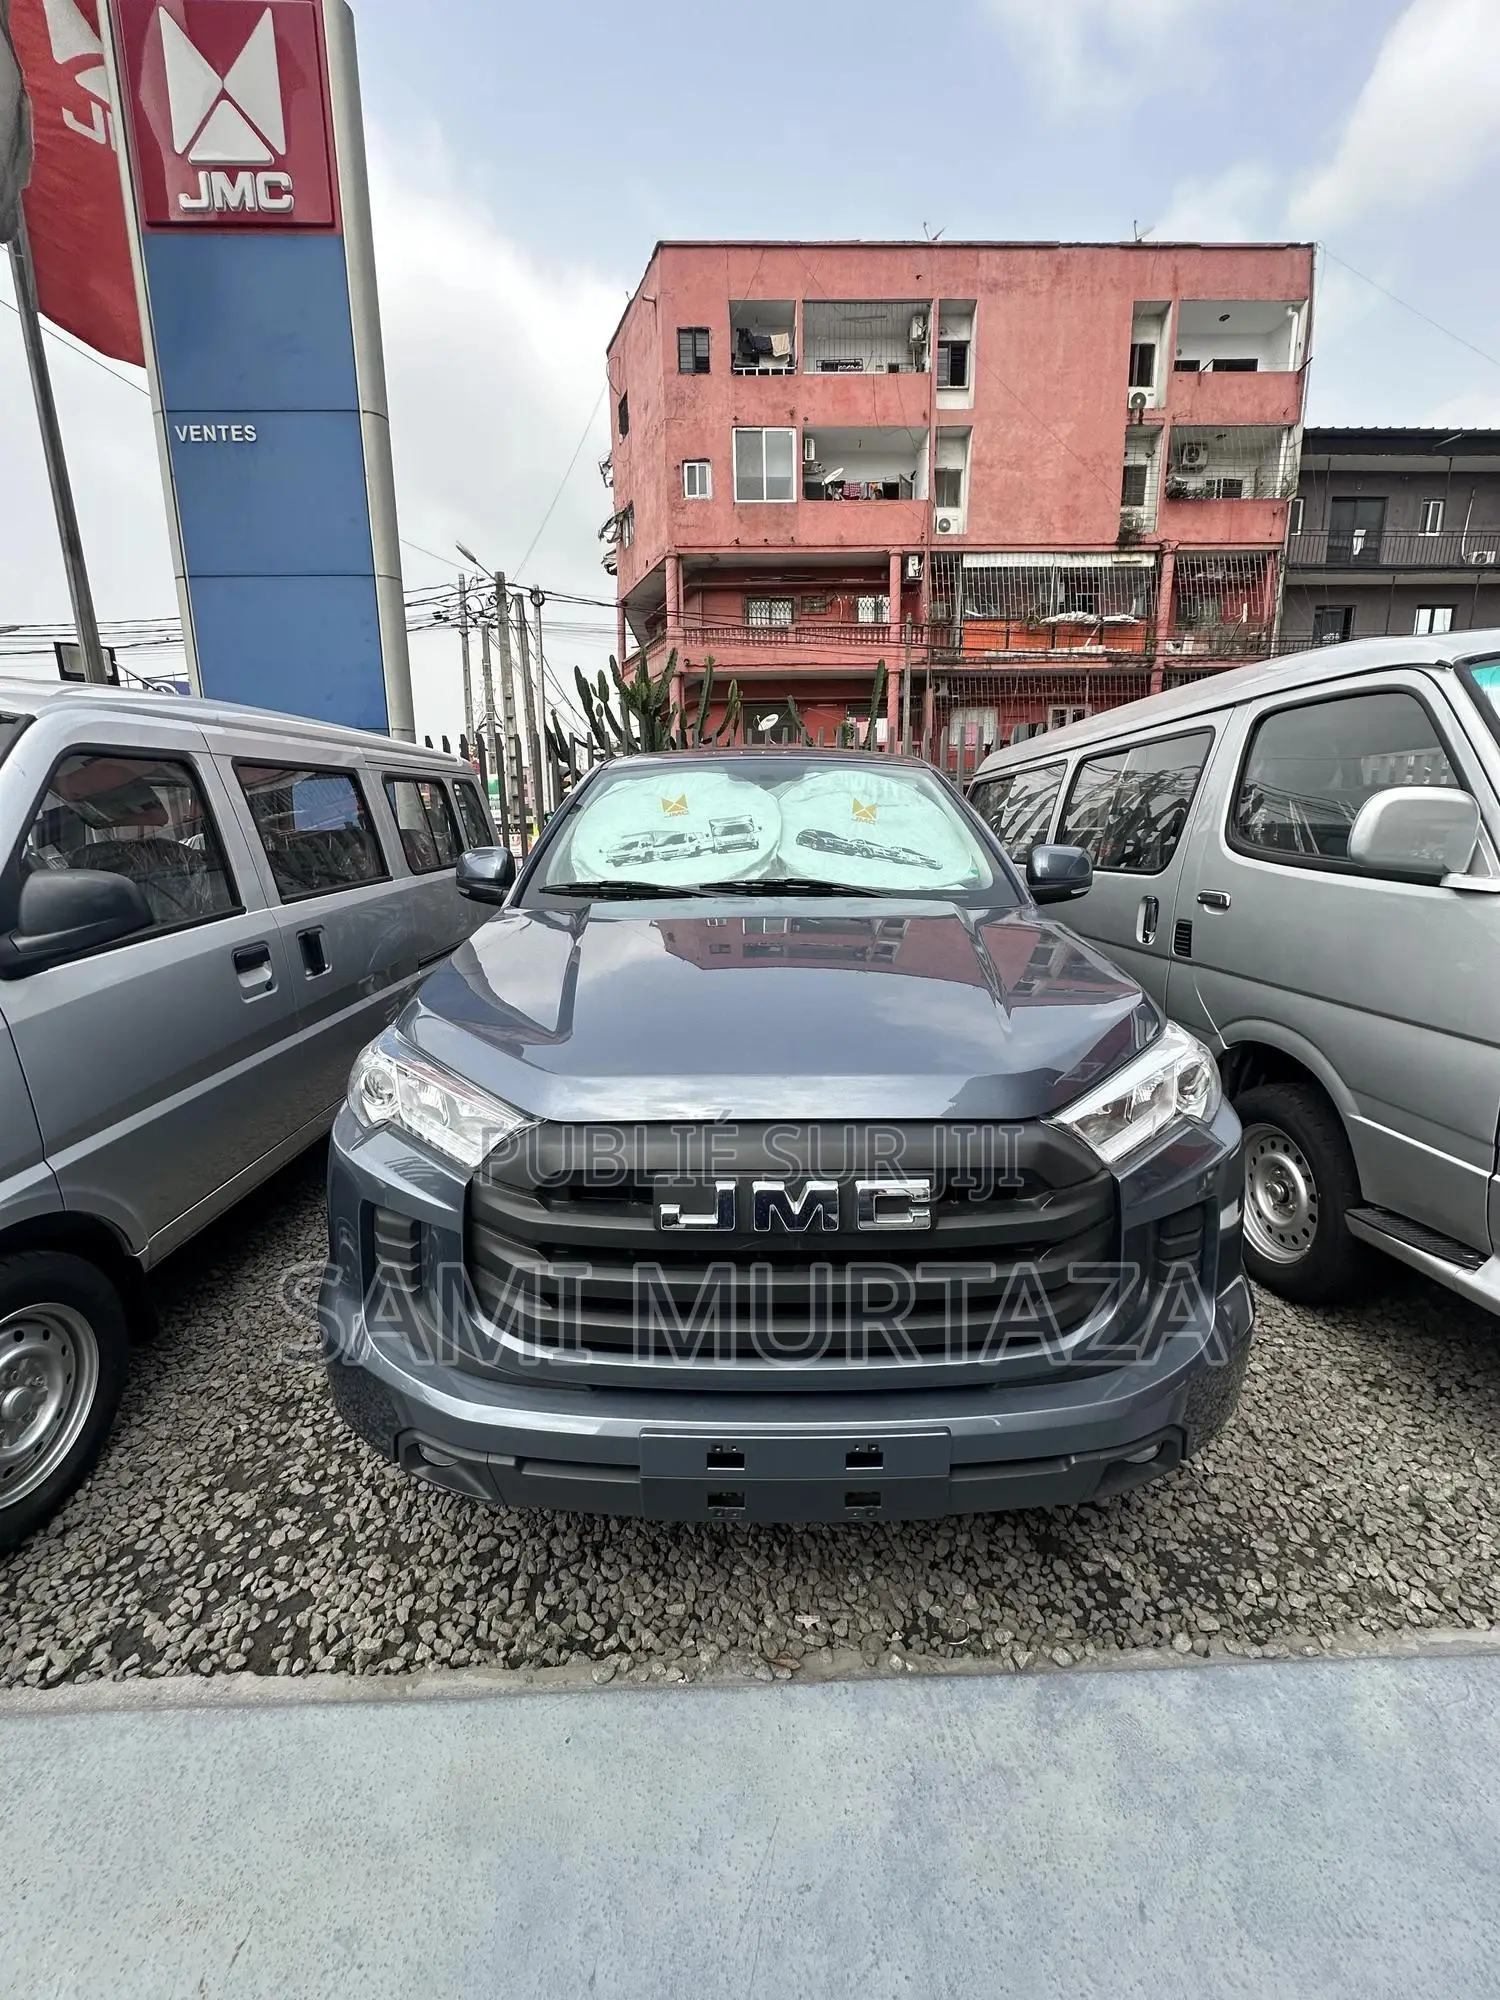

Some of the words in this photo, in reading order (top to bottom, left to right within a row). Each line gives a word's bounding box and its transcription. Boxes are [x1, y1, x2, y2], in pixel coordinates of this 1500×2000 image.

[178, 171, 294, 213] JMC
[175, 424, 257, 442] VENTES
[660, 1179, 931, 1232] JMC
